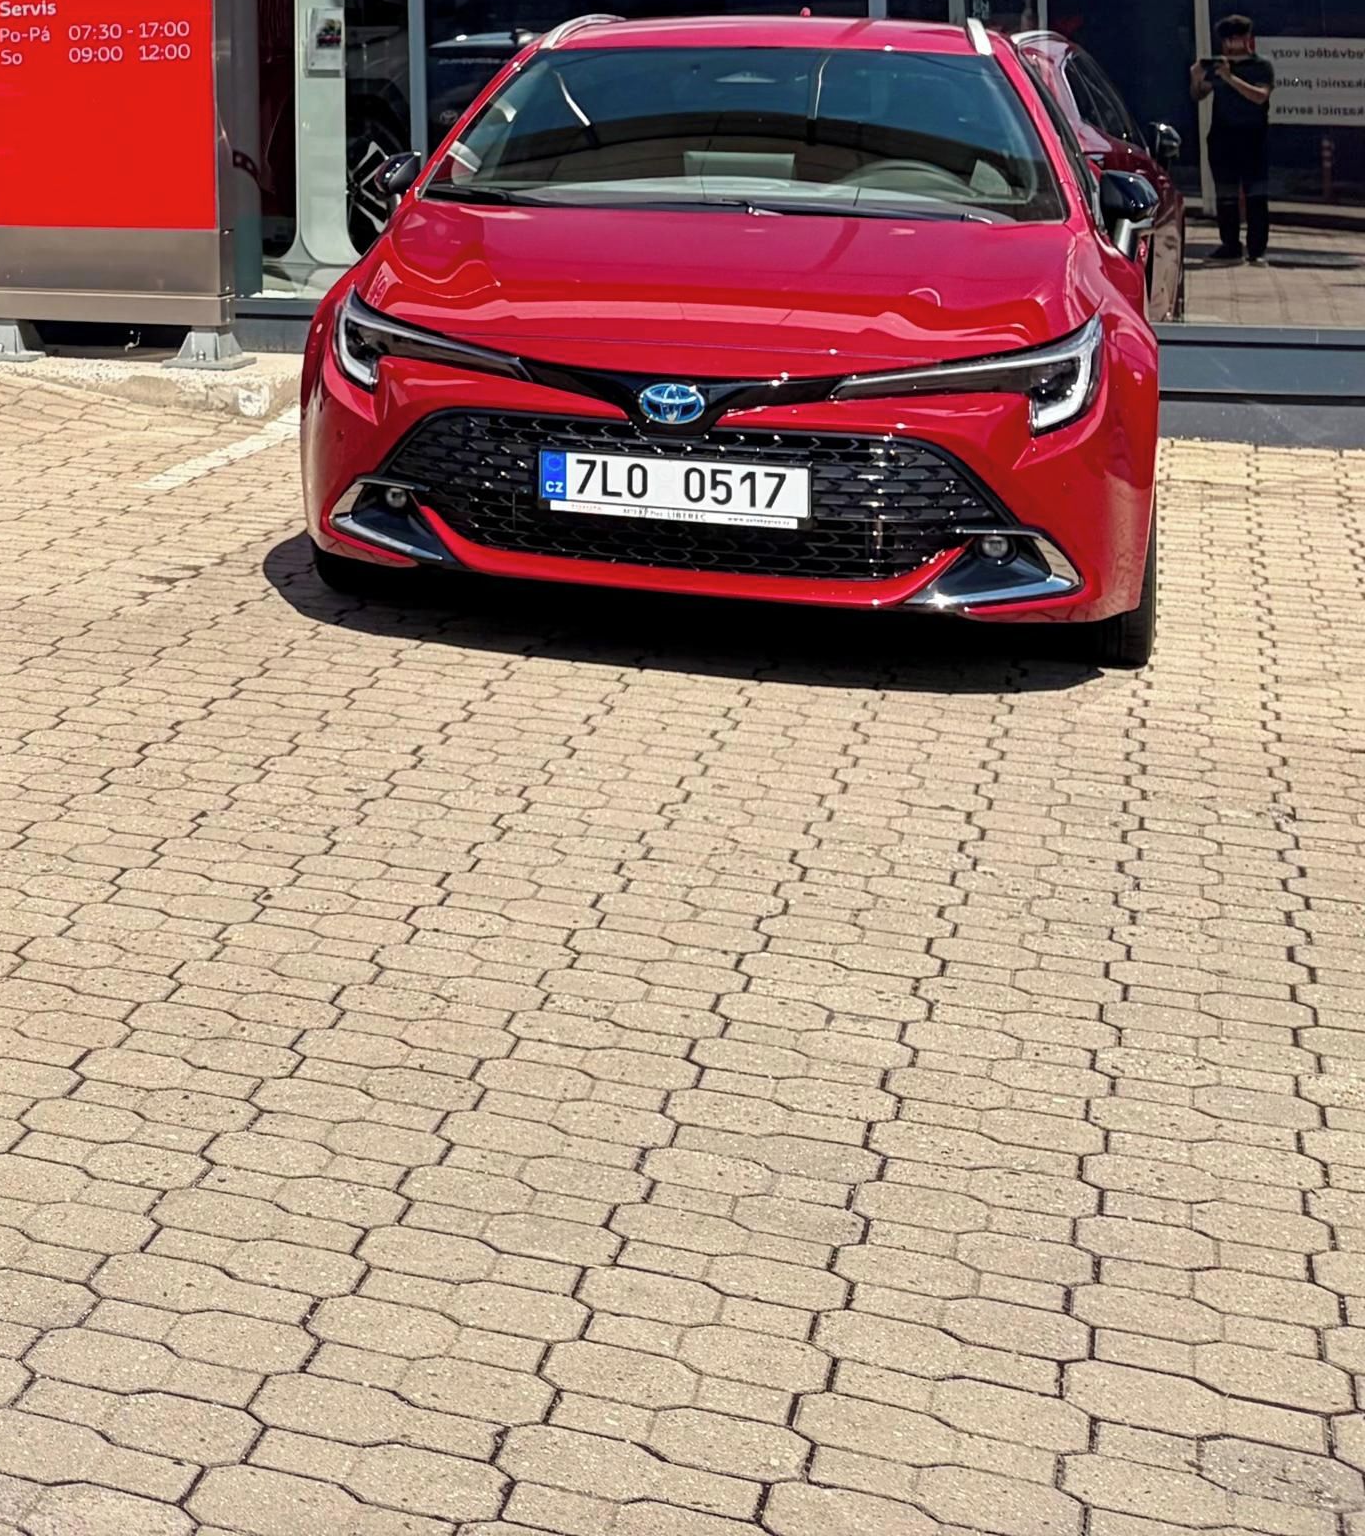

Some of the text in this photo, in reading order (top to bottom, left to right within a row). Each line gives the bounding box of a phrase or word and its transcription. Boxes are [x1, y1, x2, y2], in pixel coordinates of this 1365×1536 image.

[0, 0, 57, 18] Servis
[0, 26, 50, 43] Po-Pá
[68, 23, 122, 41] 07:30
[139, 20, 190, 38] 17:00
[0, 43, 191, 66] So 09:00 12:00
[545, 482, 564, 494] CZ
[684, 467, 787, 509] 0517
